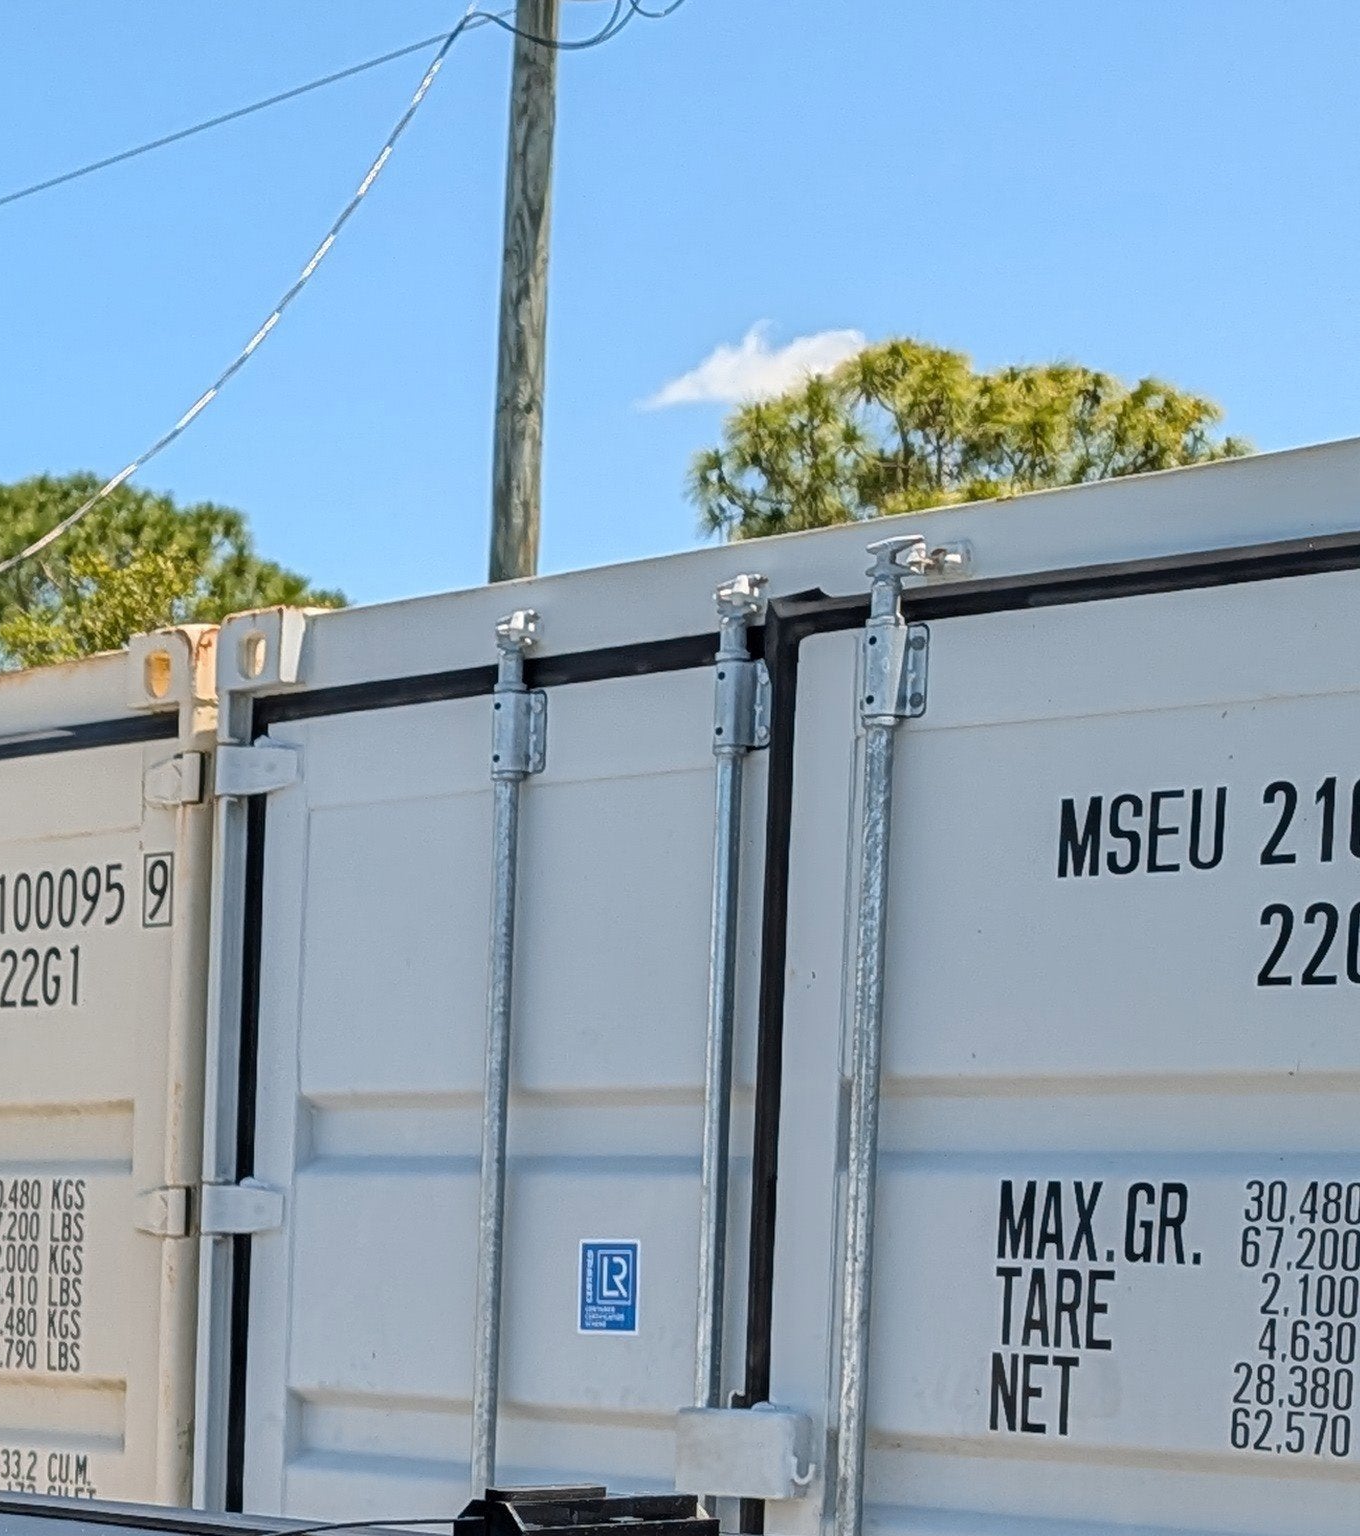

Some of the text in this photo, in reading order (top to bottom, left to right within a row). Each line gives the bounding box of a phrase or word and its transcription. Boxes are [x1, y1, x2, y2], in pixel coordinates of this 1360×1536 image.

[1057, 776, 1360, 879] MSEU 21
[146, 857, 170, 921] 9
[0, 944, 80, 1009] 22G1
[51, 1179, 86, 1211] KGS
[1244, 1179, 1360, 1226] 30,480
[49, 1211, 85, 1244] LBS
[1240, 1225, 1360, 1271] 67,200
[48, 1243, 83, 1276] KGS
[47, 1276, 82, 1308] LBS
[996, 1266, 1359, 1351] TARE 2,100
[47, 1308, 81, 1341] KGS
[1258, 1317, 1357, 1364] 4,630
[46, 1340, 81, 1373] LBS
[989, 1352, 1354, 1436] NET 28,380
[1230, 1407, 1352, 1458] 62,570
[0, 1448, 38, 1483] 33.2
